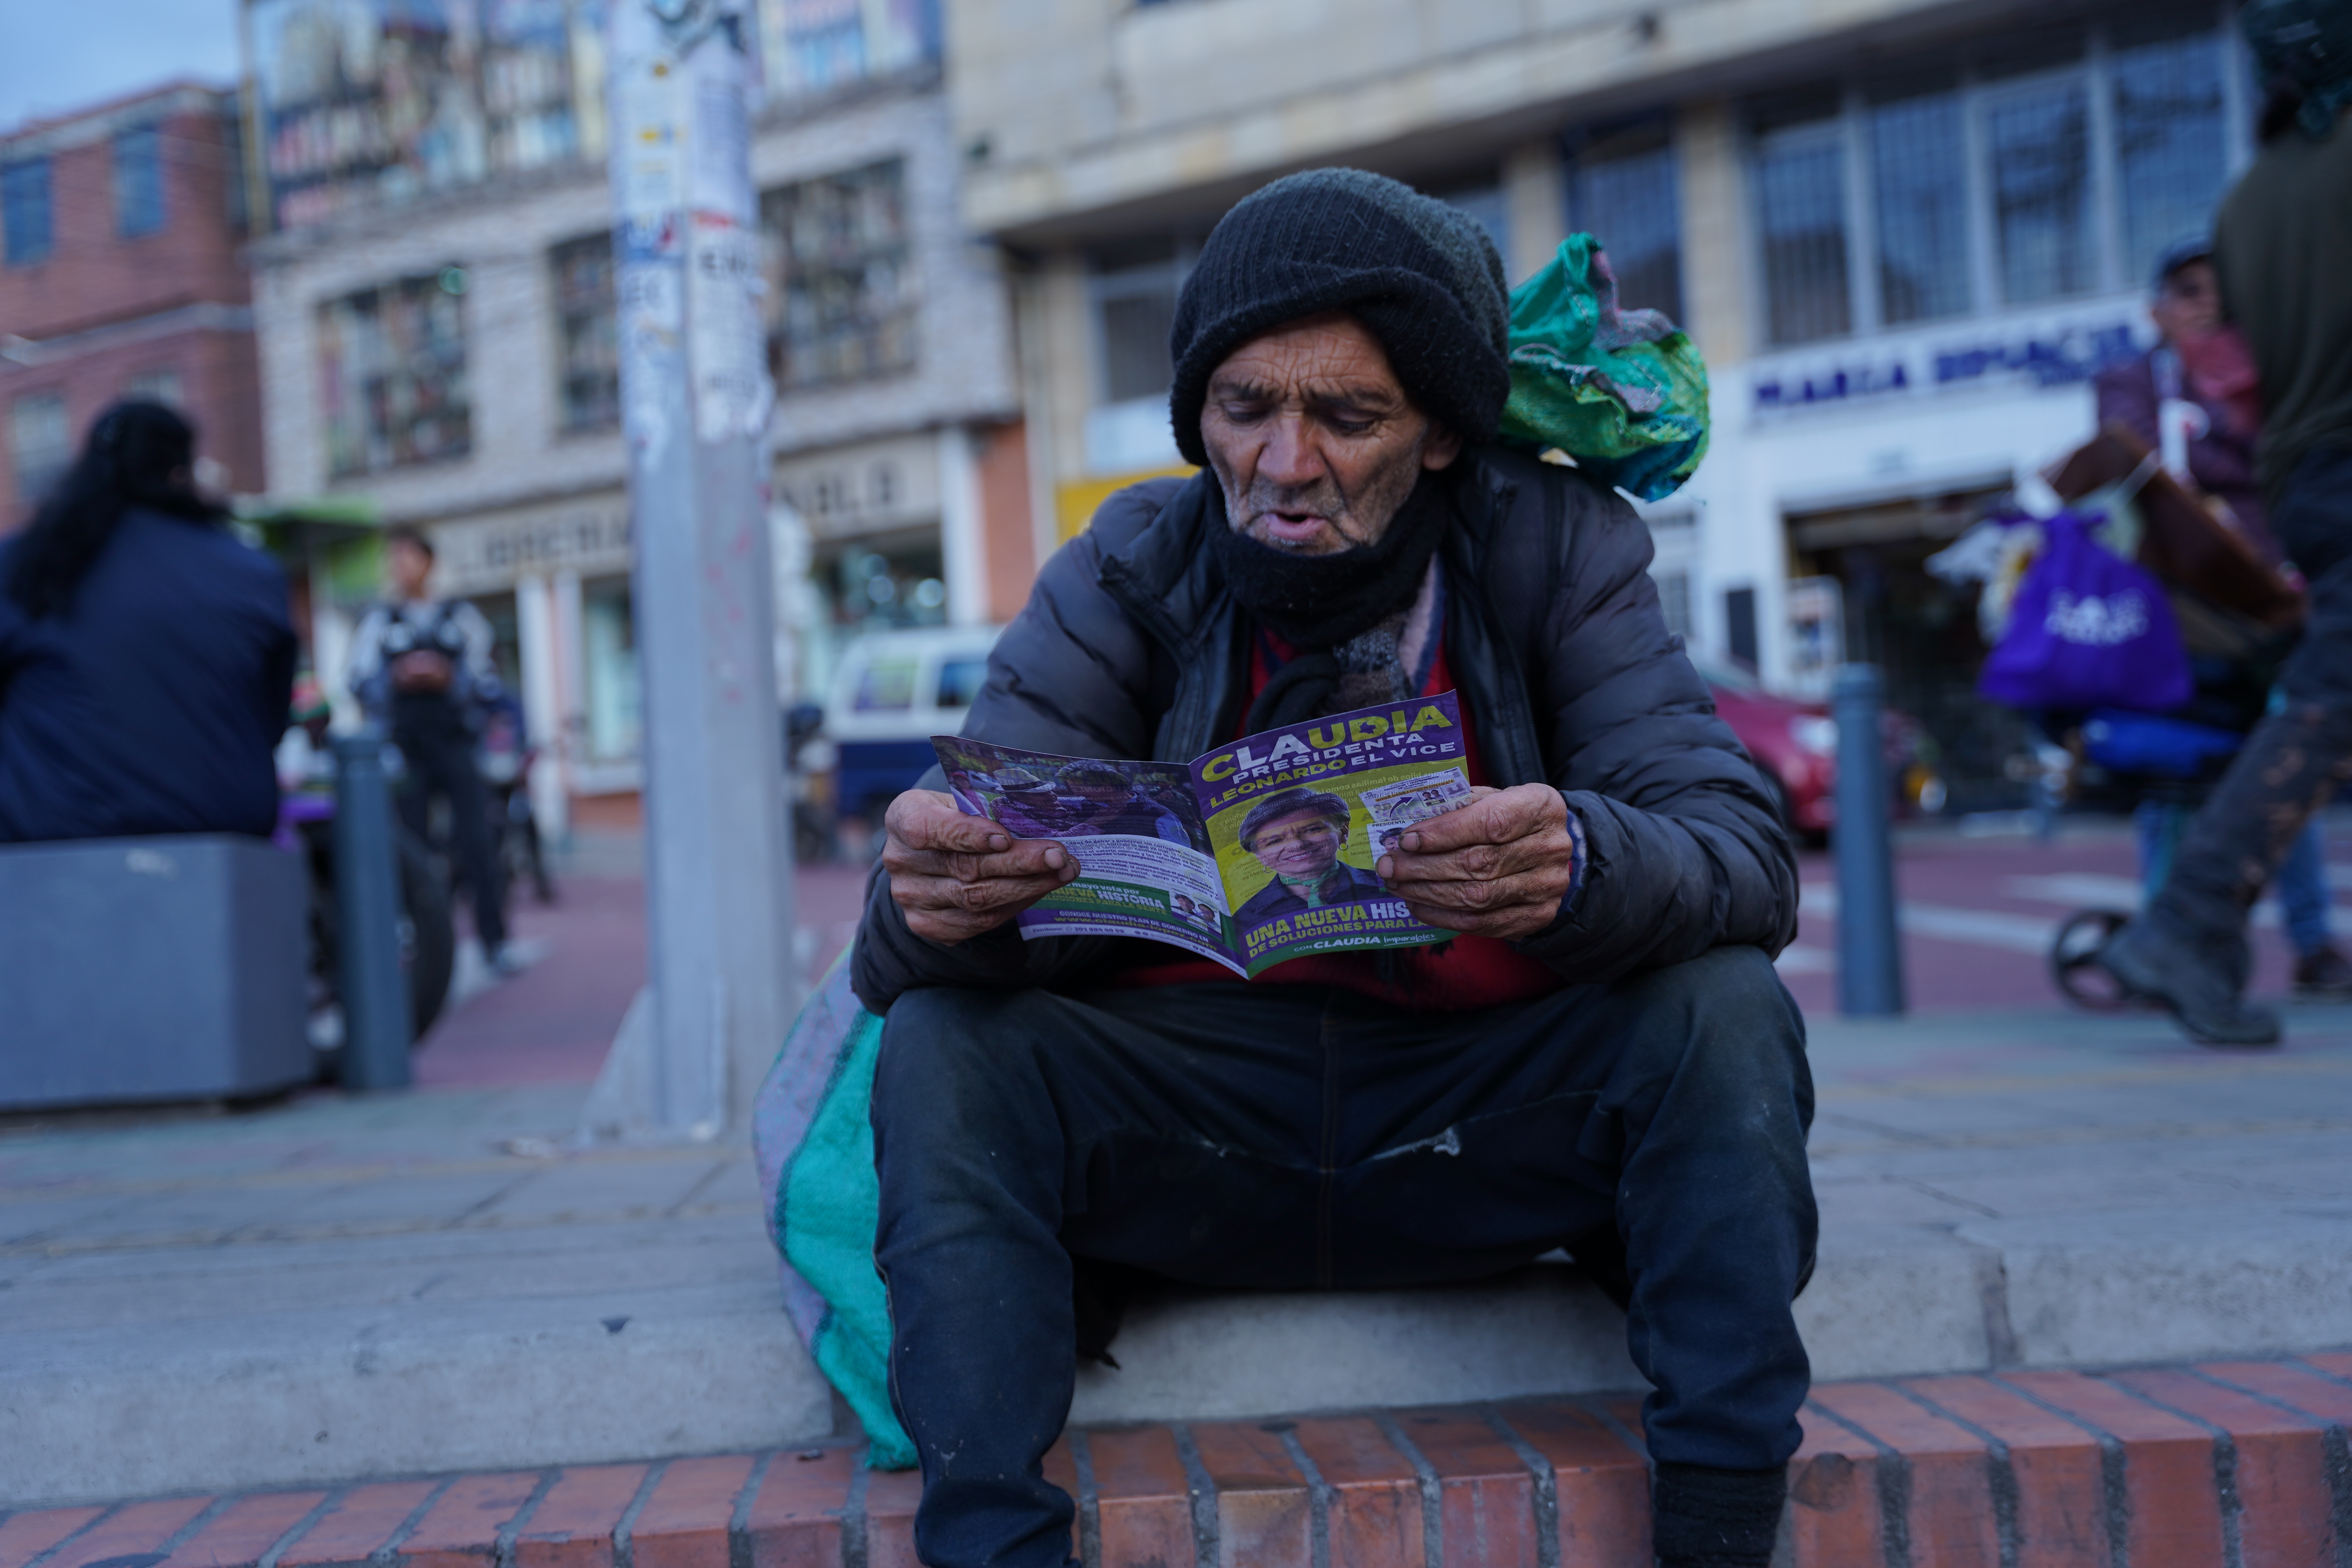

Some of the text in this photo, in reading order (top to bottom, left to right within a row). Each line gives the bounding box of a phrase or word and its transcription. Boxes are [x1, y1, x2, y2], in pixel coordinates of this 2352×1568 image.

[1201, 705, 1453, 782] CLAUDIA
[1232, 733, 1425, 785] PRESIDENTA
[1210, 760, 1346, 808] LEONARDO
[1351, 753, 1383, 766] EL
[1390, 742, 1456, 758] VICE
[1097, 890, 1165, 910] HISTORIA
[1091, 912, 1127, 921] NUESTRO
[1129, 916, 1149, 925] PLAN
[1161, 922, 1198, 938] GOBIERNO
[1199, 934, 1209, 943] EN
[1245, 902, 1410, 948] UNA NUEVA HIS
[1249, 945, 1267, 958] DE
[1269, 921, 1362, 948] SOLUCIONES
[1365, 918, 1406, 930] PARA
[1294, 933, 1436, 953] CON CLAUDIA Imparables
